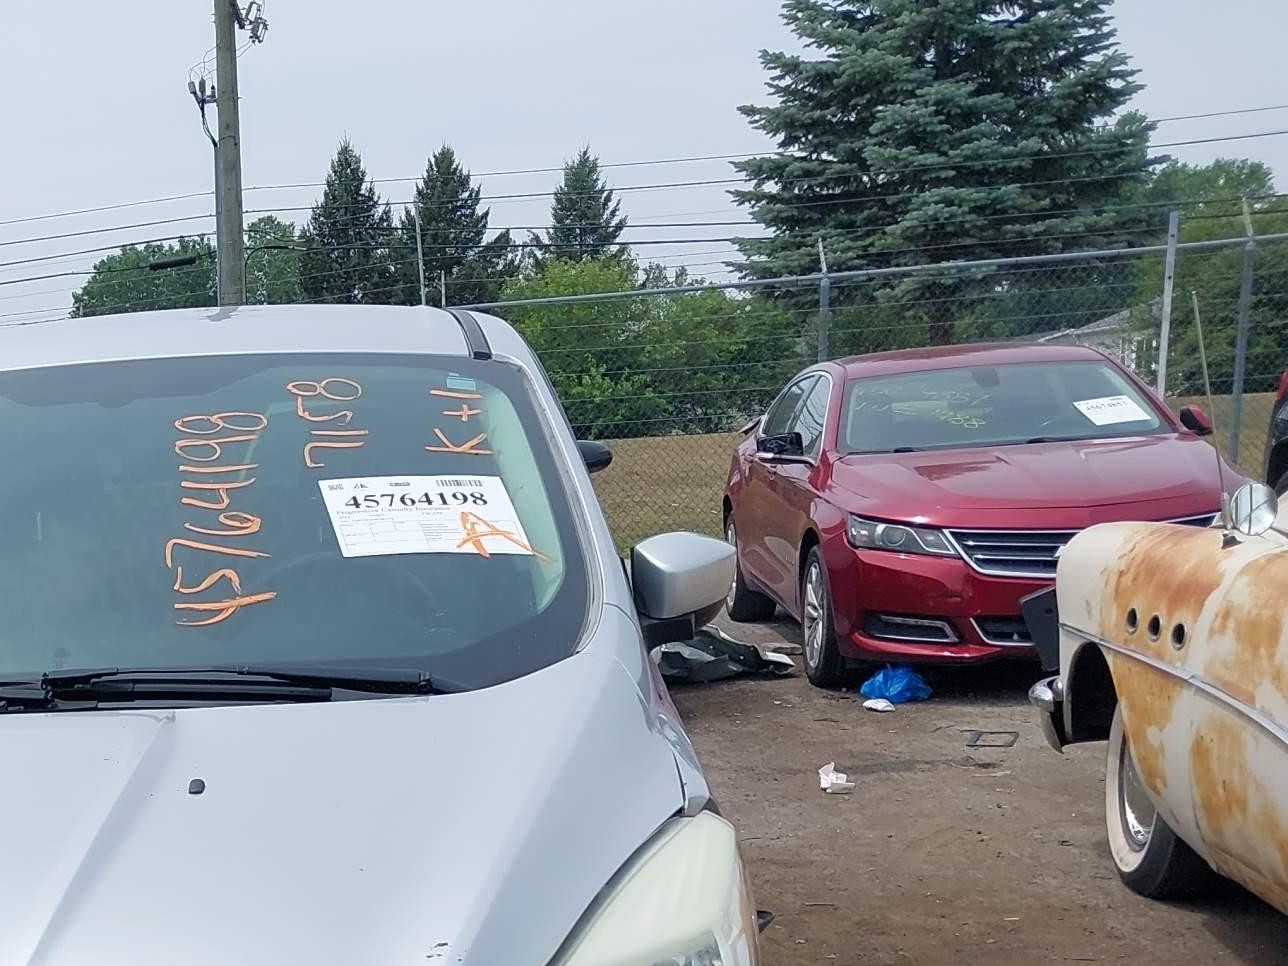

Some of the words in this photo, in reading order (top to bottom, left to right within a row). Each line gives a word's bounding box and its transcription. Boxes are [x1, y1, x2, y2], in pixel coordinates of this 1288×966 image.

[285, 377, 369, 469] 7158
[164, 411, 278, 627] 45764198
[344, 491, 489, 509] 45764198
